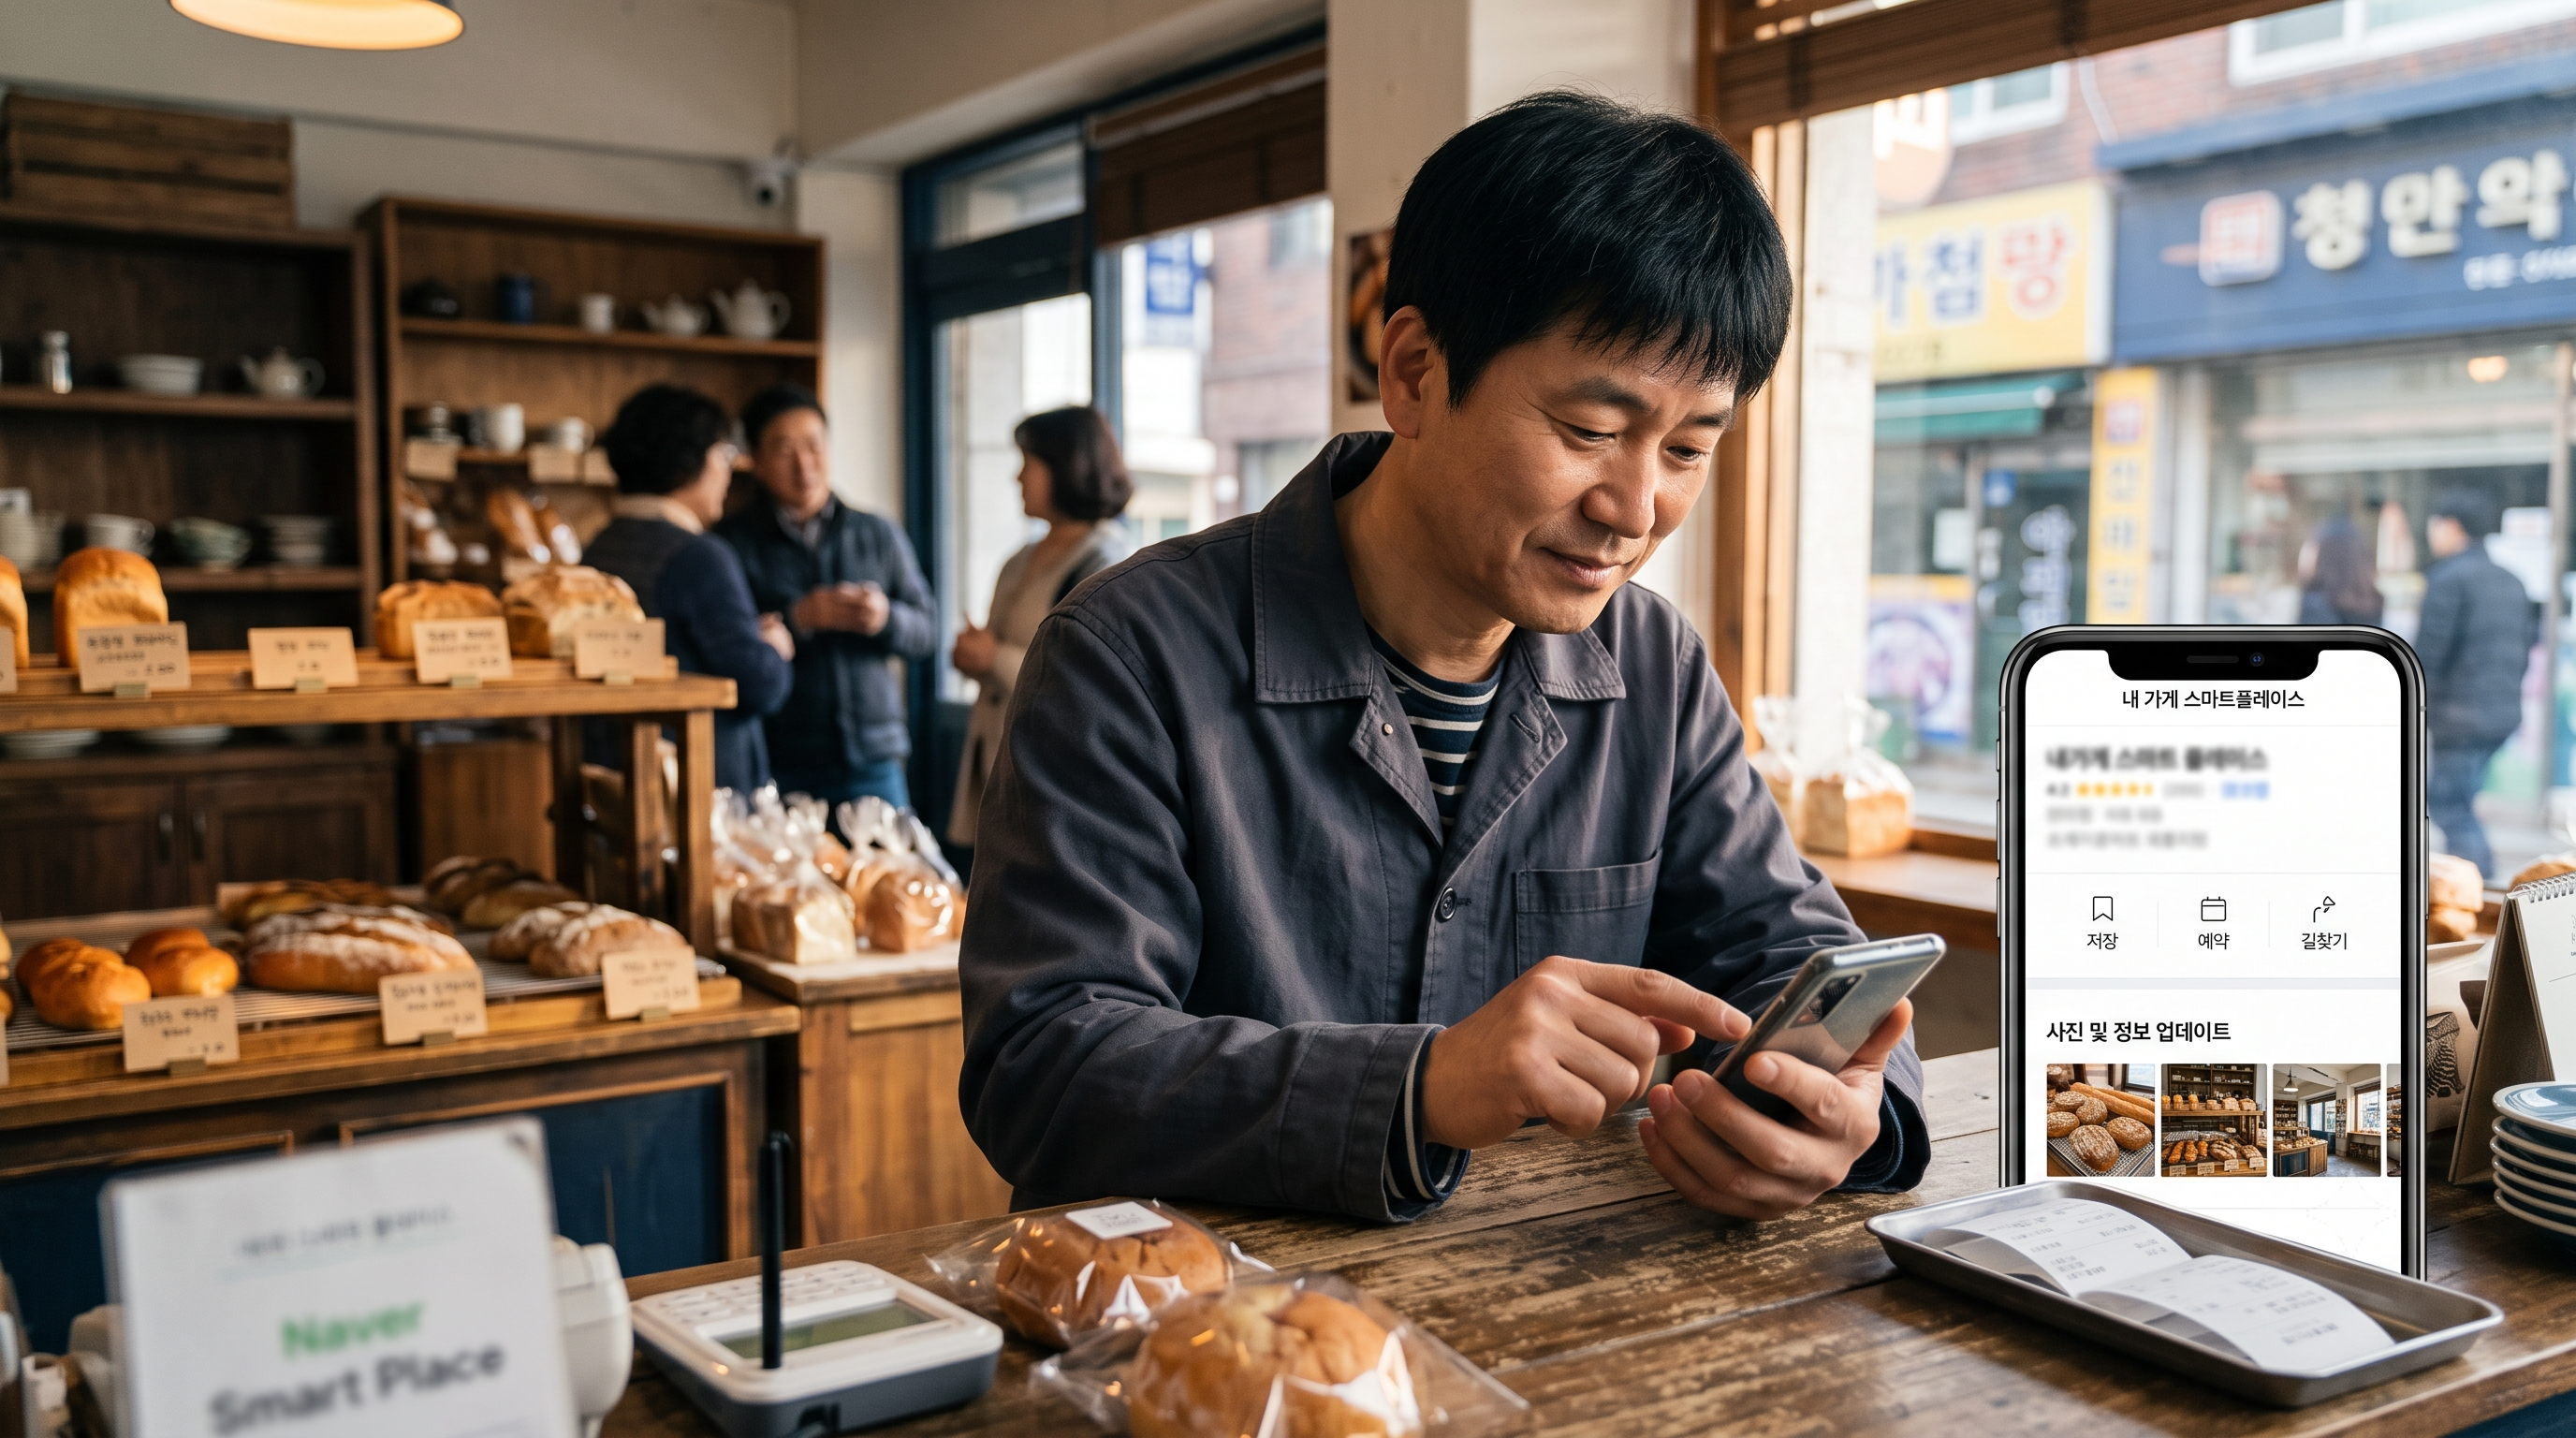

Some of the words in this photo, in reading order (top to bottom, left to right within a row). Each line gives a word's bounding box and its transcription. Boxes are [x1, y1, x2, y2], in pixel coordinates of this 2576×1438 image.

[2122, 689, 2139, 710] 내
[2144, 689, 2178, 710] 가게
[2183, 689, 2305, 710] 스마트플레이스
[2086, 932, 2119, 950] 저장
[2198, 932, 2231, 950] 예약
[2301, 932, 2348, 950] 길찾기
[2045, 1020, 2084, 1043] 사진
[2089, 1020, 2108, 1043] 및
[2113, 1020, 2152, 1043] 정보
[2156, 1020, 2232, 1043] 업데이트
[282, 1304, 426, 1357] Naver
[210, 1369, 365, 1434] Smart
[376, 1343, 504, 1399] Place
